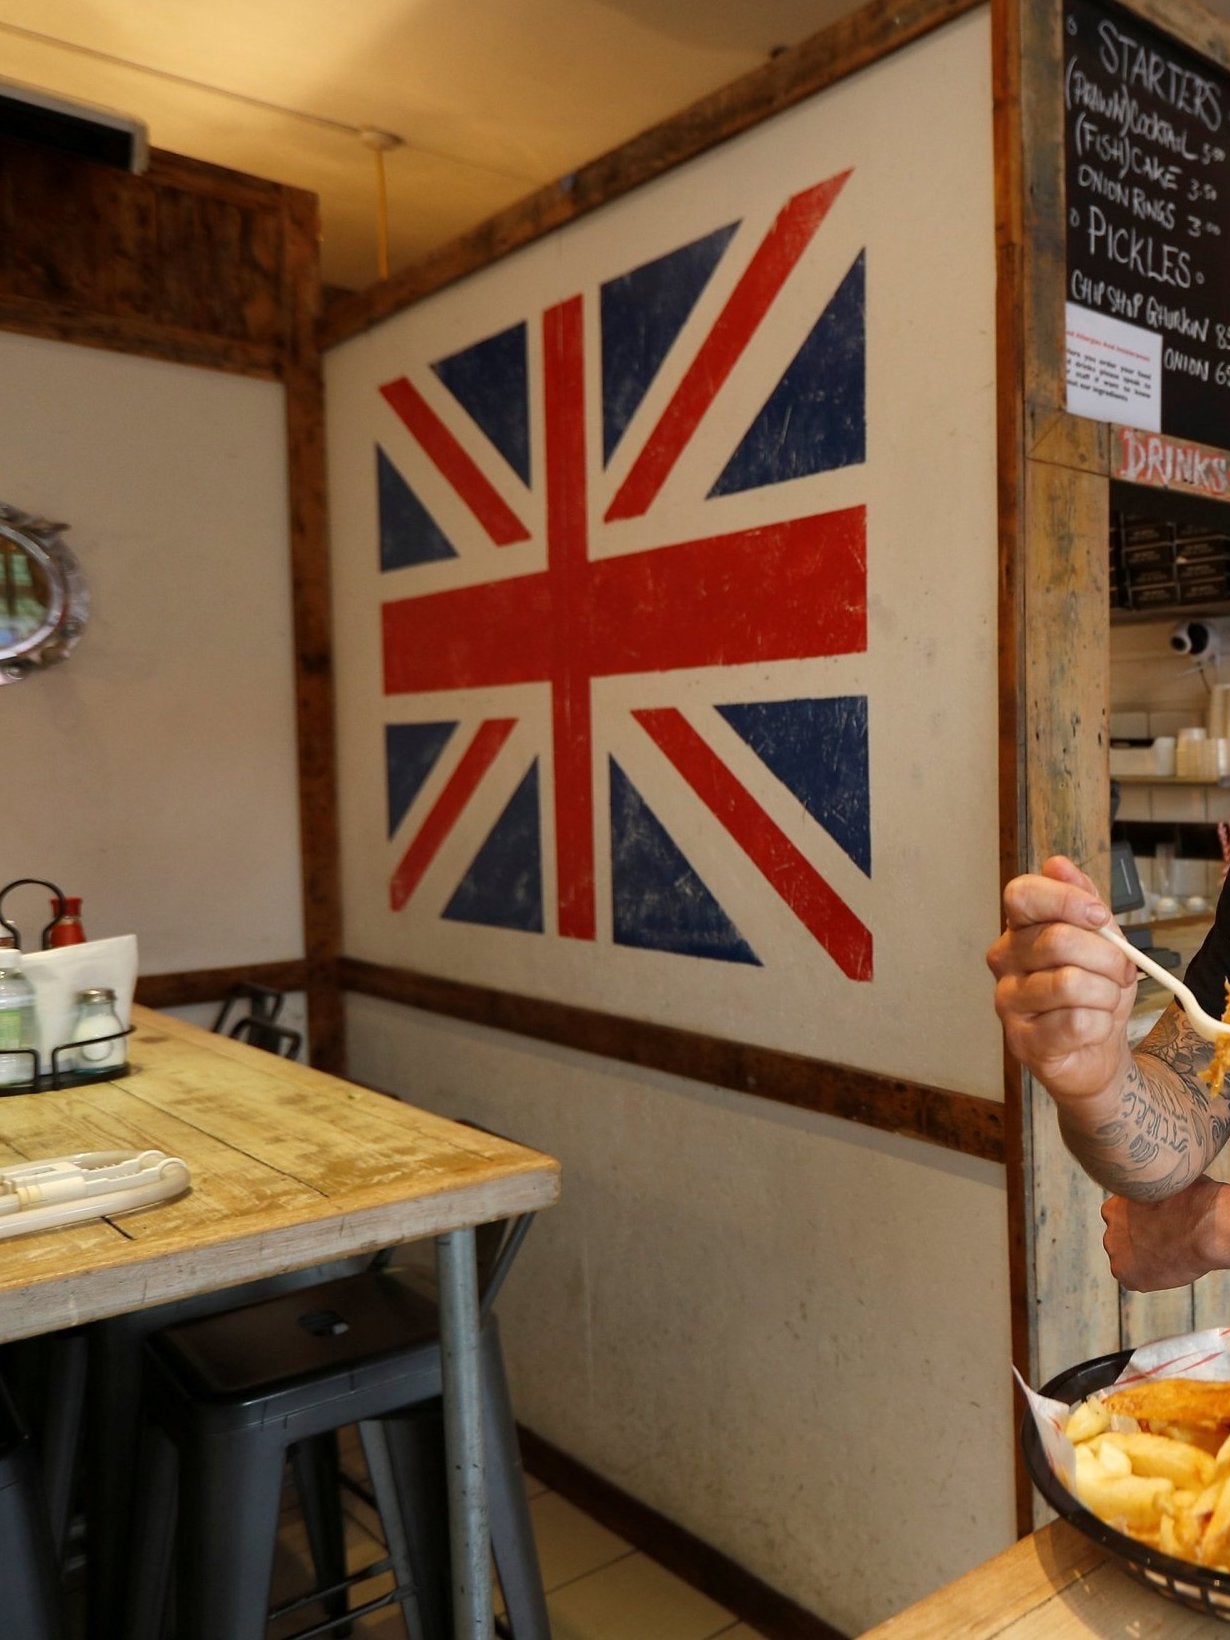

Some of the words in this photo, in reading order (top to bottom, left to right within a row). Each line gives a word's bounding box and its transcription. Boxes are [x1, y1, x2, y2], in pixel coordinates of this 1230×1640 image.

[1098, 20, 1222, 131] STARTERS
[1078, 164, 1130, 207] ONION
[1132, 188, 1176, 231] RINGS
[1089, 206, 1191, 288] PICKLES
[1071, 268, 1106, 306] CHIP
[1107, 285, 1144, 319] SHOP
[1164, 348, 1210, 382] ONION
[1117, 427, 1228, 493] DRINKS
